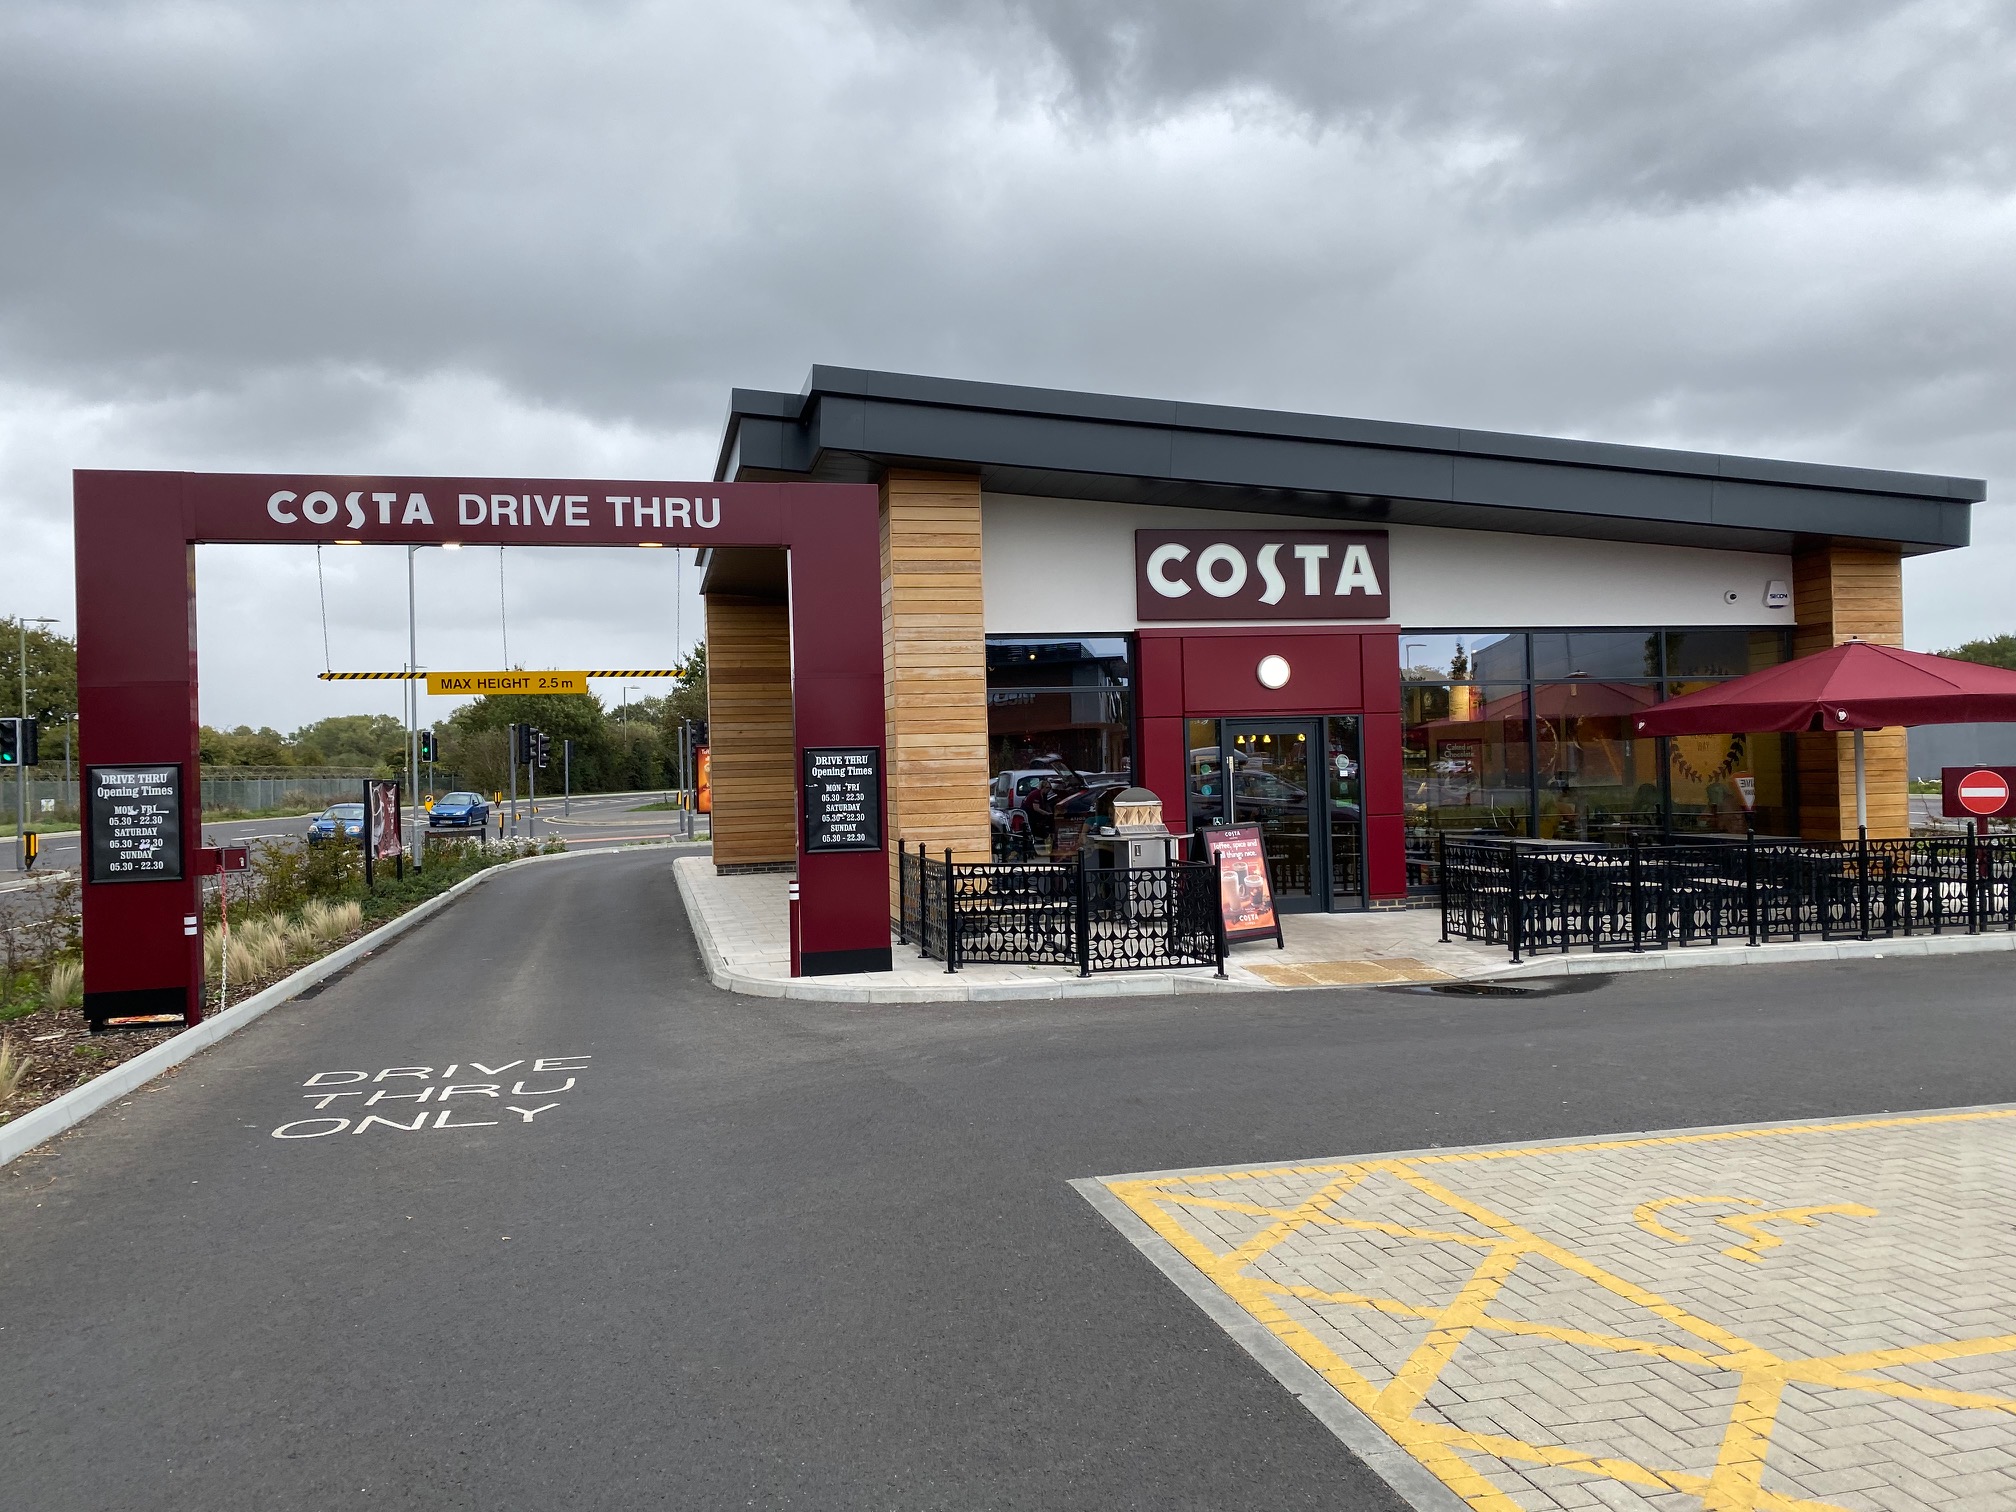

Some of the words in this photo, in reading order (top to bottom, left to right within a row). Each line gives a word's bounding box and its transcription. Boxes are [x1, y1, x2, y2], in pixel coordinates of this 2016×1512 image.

[267, 490, 434, 530] COSTA
[458, 493, 590, 526] DRIVE
[605, 496, 721, 528] THRU
[1146, 543, 1382, 605] COSTA
[441, 678, 471, 689] MAX
[477, 678, 530, 689] HEIGHT
[538, 677, 558, 689] 2.5
[561, 680, 573, 688] m
[815, 756, 842, 765] DRIVE
[844, 755, 868, 765] THRU
[812, 767, 845, 778] Opening
[847, 766, 872, 776] Times
[101, 774, 135, 785] DRIVE
[138, 773, 168, 784] THRU
[98, 787, 139, 799] Opening
[141, 786, 173, 796] Times
[825, 784, 841, 792] MON
[847, 783, 860, 791] FRI
[821, 794, 840, 802] 05.30
[846, 793, 865, 801] 22.30
[114, 805, 134, 815] MON
[141, 804, 157, 814] FRI
[826, 803, 860, 812] SATURDAY
[109, 817, 132, 826] 05.30
[139, 816, 163, 825] 22.30
[821, 814, 841, 822] 05.30
[846, 813, 865, 821] 22.30
[114, 828, 157, 837] SATURDAY
[830, 824, 857, 832] SUNDAY
[109, 840, 132, 849] 05.30
[140, 838, 163, 848] 22.30
[822, 834, 841, 843] 05.30
[846, 833, 866, 842] 22.30
[1213, 841, 1232, 850] Toffee,
[1233, 840, 1247, 851] spice
[1247, 839, 1258, 847] and
[120, 850, 153, 860] SUNDAY
[1227, 850, 1243, 861] things
[1244, 849, 1257, 857] nice.
[110, 862, 133, 872] 05.30
[140, 861, 164, 870] 22.30
[1239, 914, 1259, 922] COSTA
[302, 1055, 592, 1087] DRIVE
[302, 1077, 576, 1110] THRU
[271, 1103, 561, 1139] ONLY
